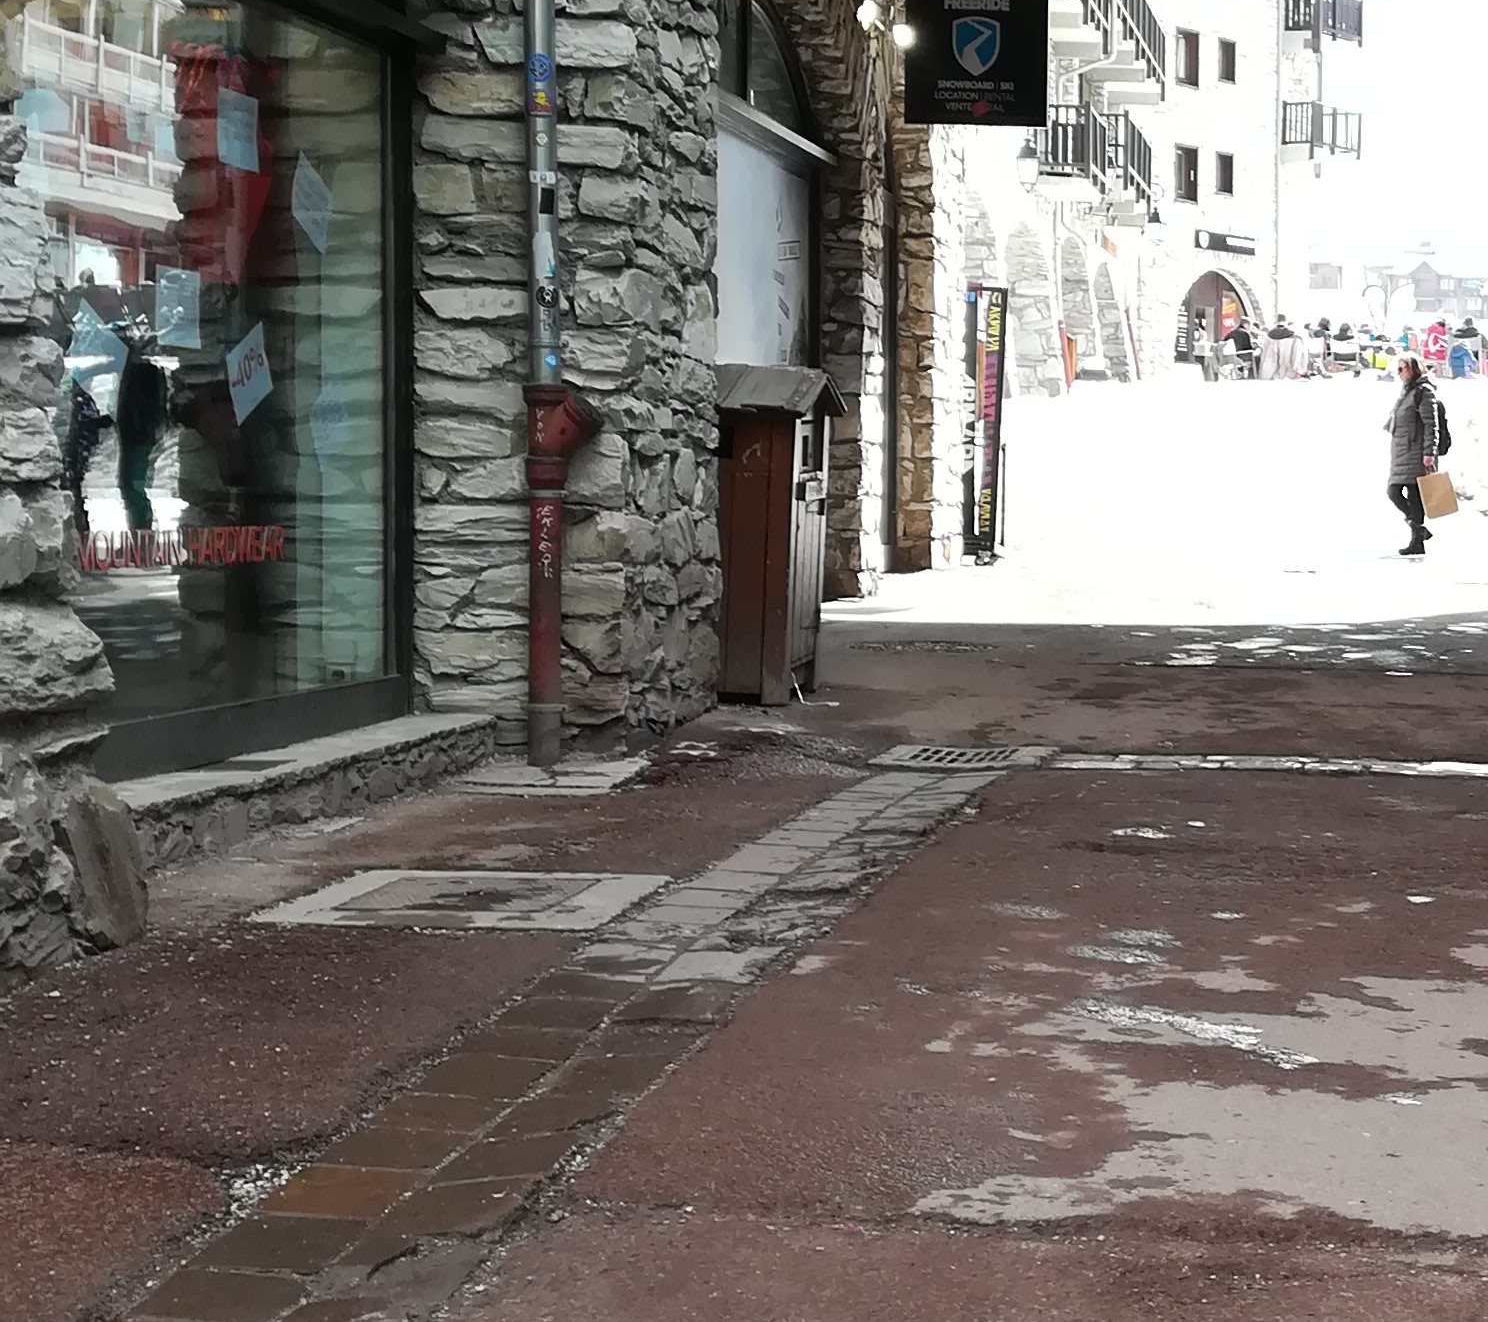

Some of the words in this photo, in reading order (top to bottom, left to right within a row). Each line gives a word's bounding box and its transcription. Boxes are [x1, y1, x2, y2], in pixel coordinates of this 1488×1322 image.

[937, 79, 994, 90] SNOWBOARD
[1000, 81, 1014, 90] SKI
[934, 90, 979, 100] LOCATION
[945, 102, 973, 111] VENTE
[77, 529, 183, 572] MOUNTAIN
[187, 525, 284, 565] HARDWEAR
